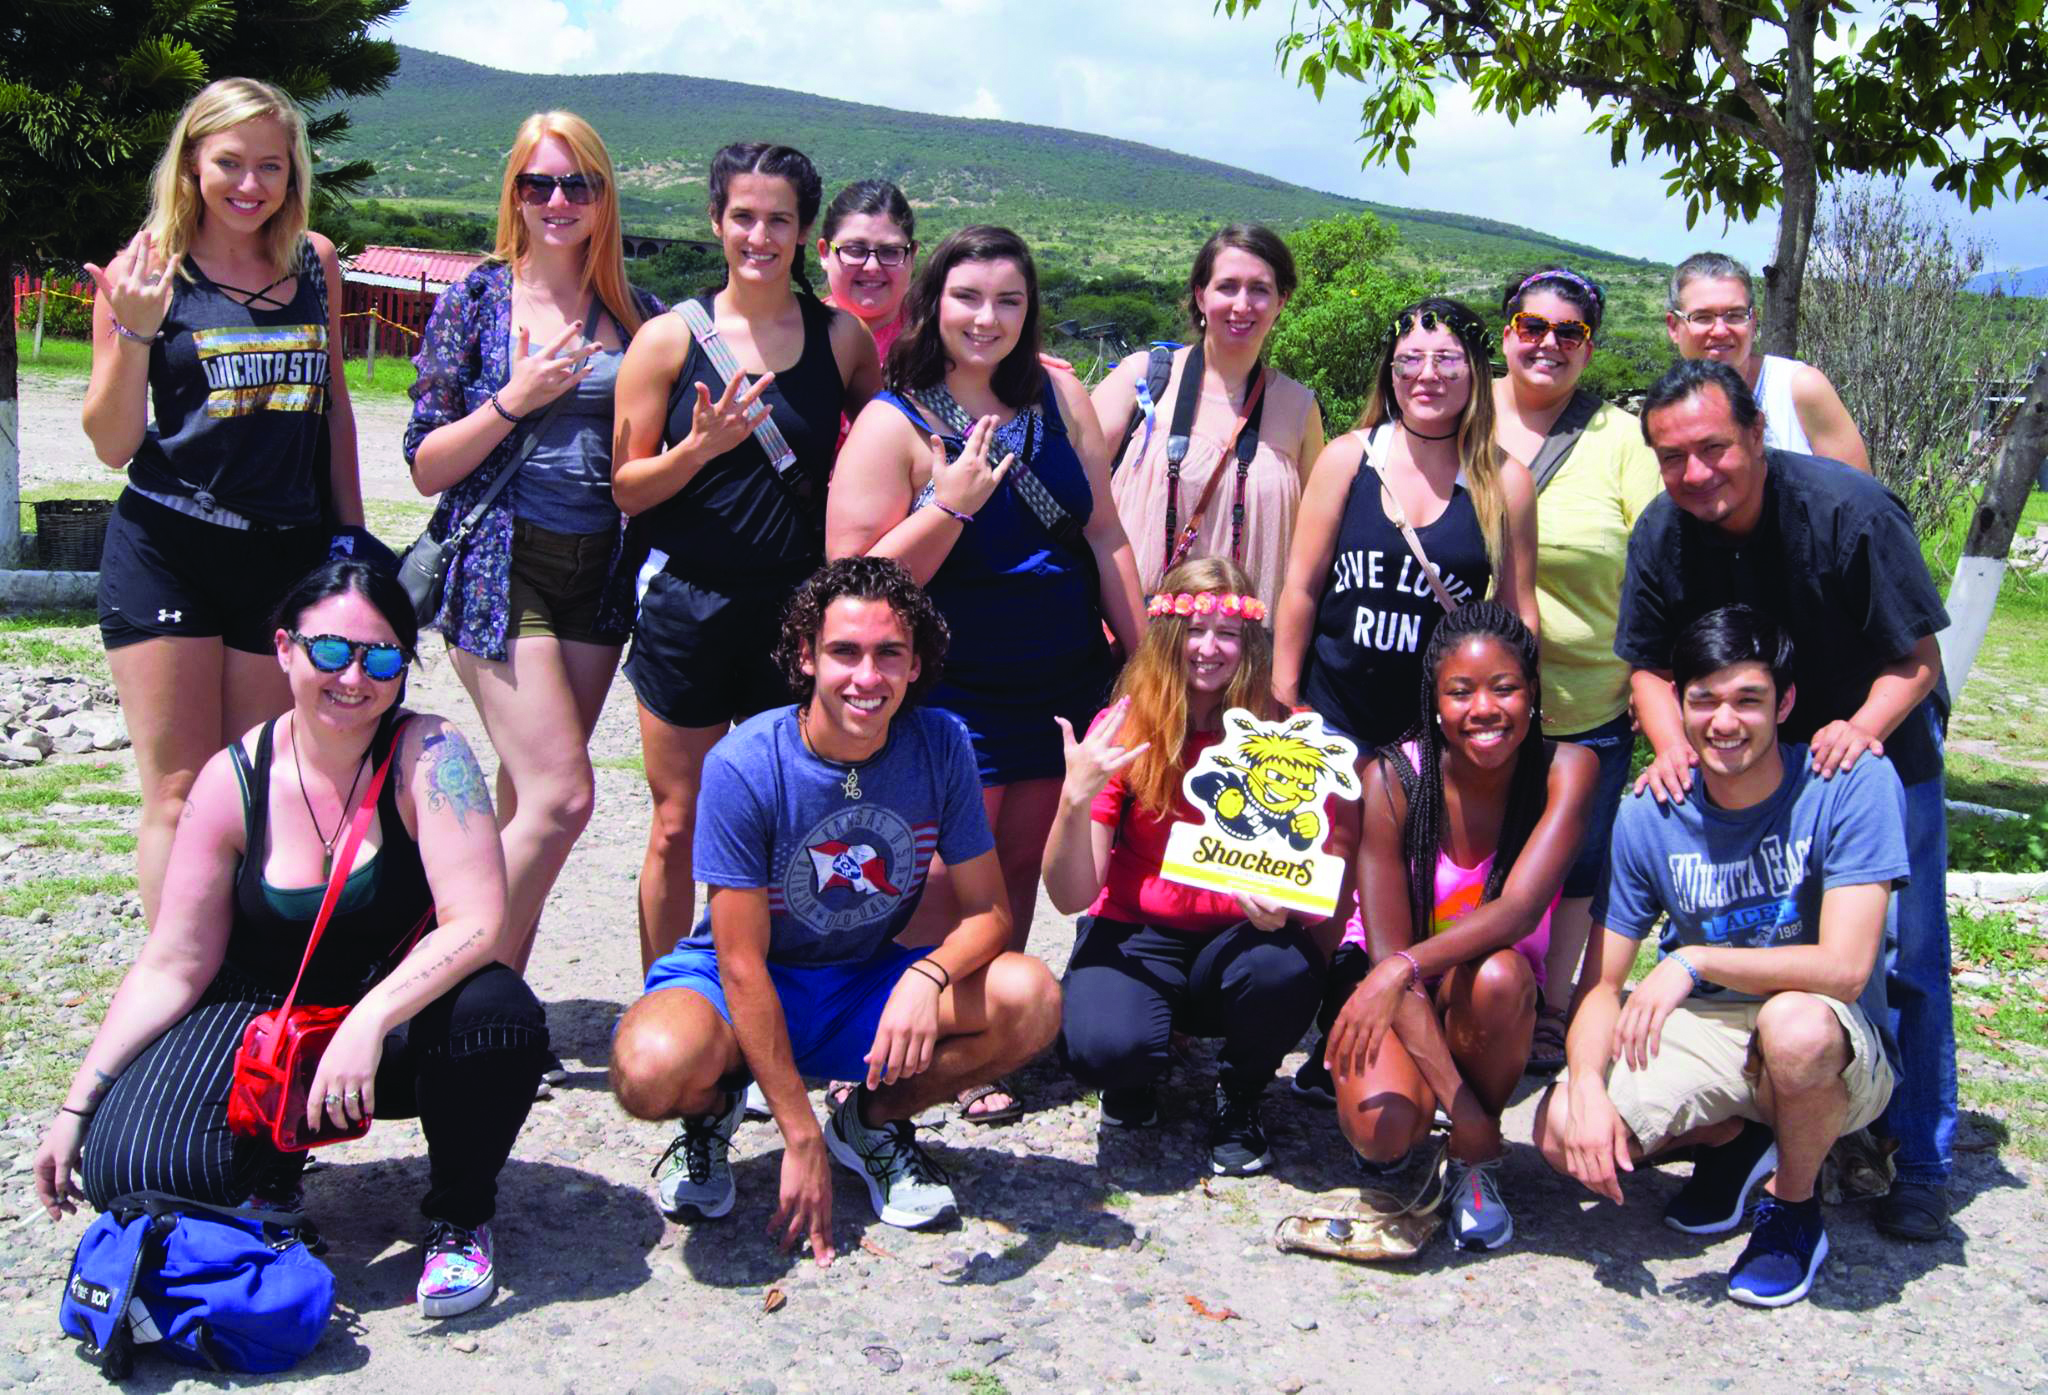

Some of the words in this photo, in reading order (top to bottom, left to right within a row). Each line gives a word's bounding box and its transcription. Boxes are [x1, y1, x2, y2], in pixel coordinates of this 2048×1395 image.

[202, 353, 287, 389] WICHITA
[288, 352, 328, 385] STA
[1334, 551, 1384, 593] LIVE
[1396, 555, 1472, 603] LOVE
[1353, 606, 1421, 653] RUN
[1193, 836, 1314, 886] Shockers
[1668, 852, 1765, 914] WICHITA
